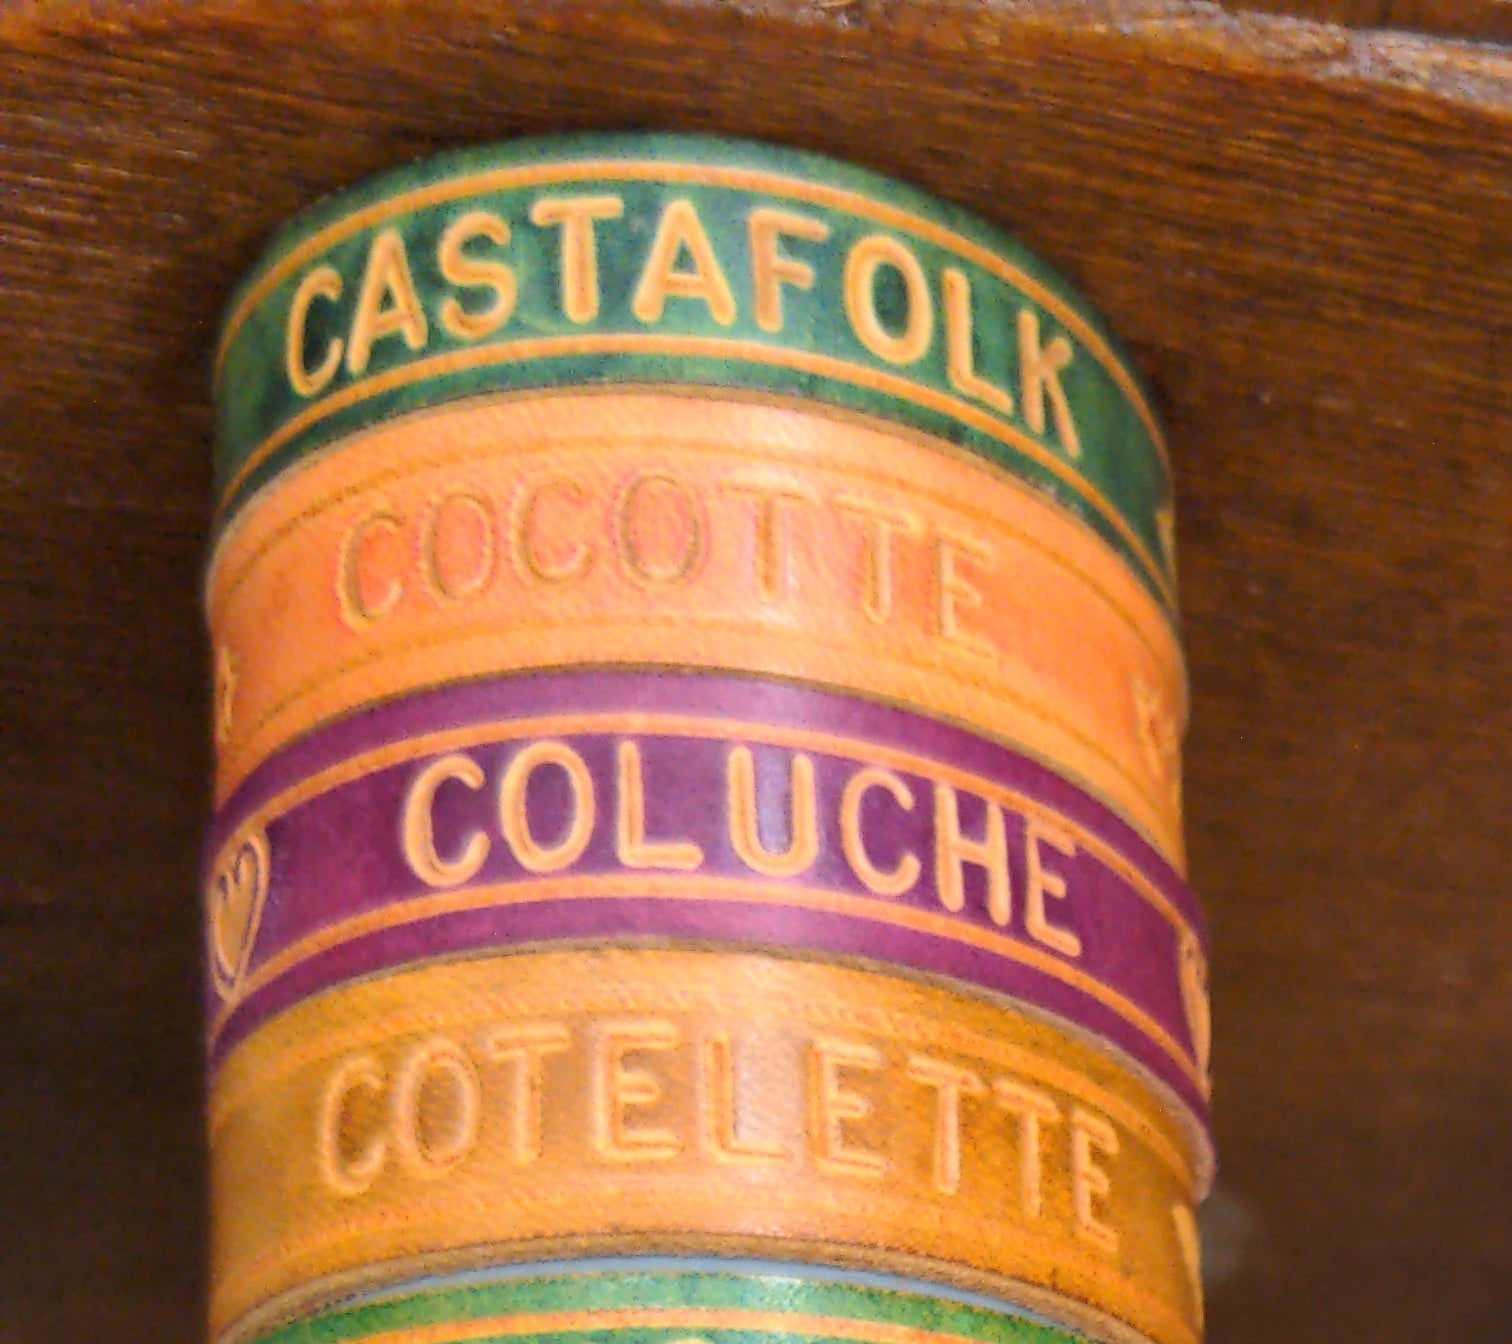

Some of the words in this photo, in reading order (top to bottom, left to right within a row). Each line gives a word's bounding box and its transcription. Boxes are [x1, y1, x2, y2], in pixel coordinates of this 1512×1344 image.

[285, 196, 1080, 458] CASTAFOLK
[337, 474, 998, 660] COCOTTE
[405, 741, 1083, 958] COLUCHE
[317, 1020, 1121, 1250] COTELETTE
